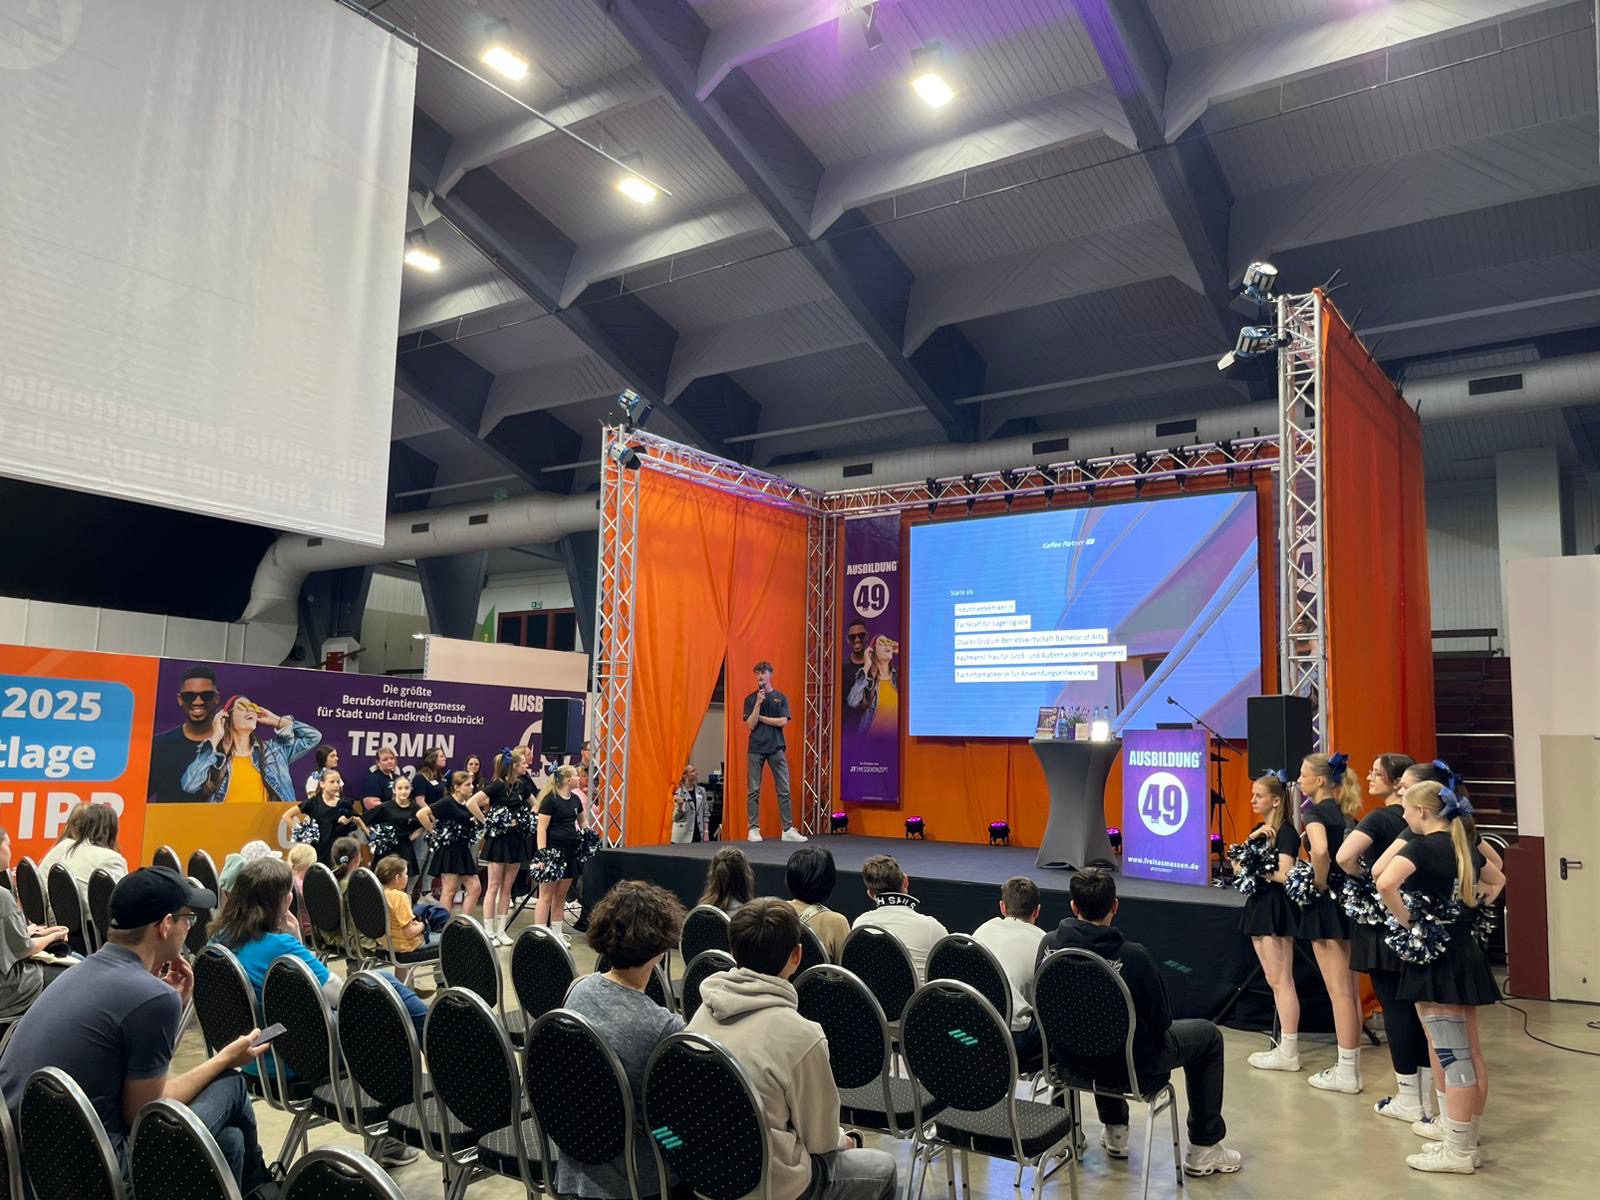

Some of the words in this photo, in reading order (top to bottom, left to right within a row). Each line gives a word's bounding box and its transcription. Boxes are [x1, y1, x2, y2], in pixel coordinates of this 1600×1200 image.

[847, 561, 897, 575] AUSBILDUNG
[857, 584, 885, 611] 49
[383, 684, 399, 694] Die
[400, 686, 432, 697] größte
[1, 687, 102, 722] 2025
[342, 695, 466, 712] Berufsorientierungsmesse
[317, 707, 334, 718] für
[335, 708, 363, 719] Stadt
[365, 710, 385, 720] und
[387, 711, 433, 723] Landkreis
[434, 713, 484, 725] Osnabrück!
[348, 730, 456, 759] TERMIN
[1129, 751, 1200, 768] AUSBILDUNG
[1142, 784, 1182, 826] 49
